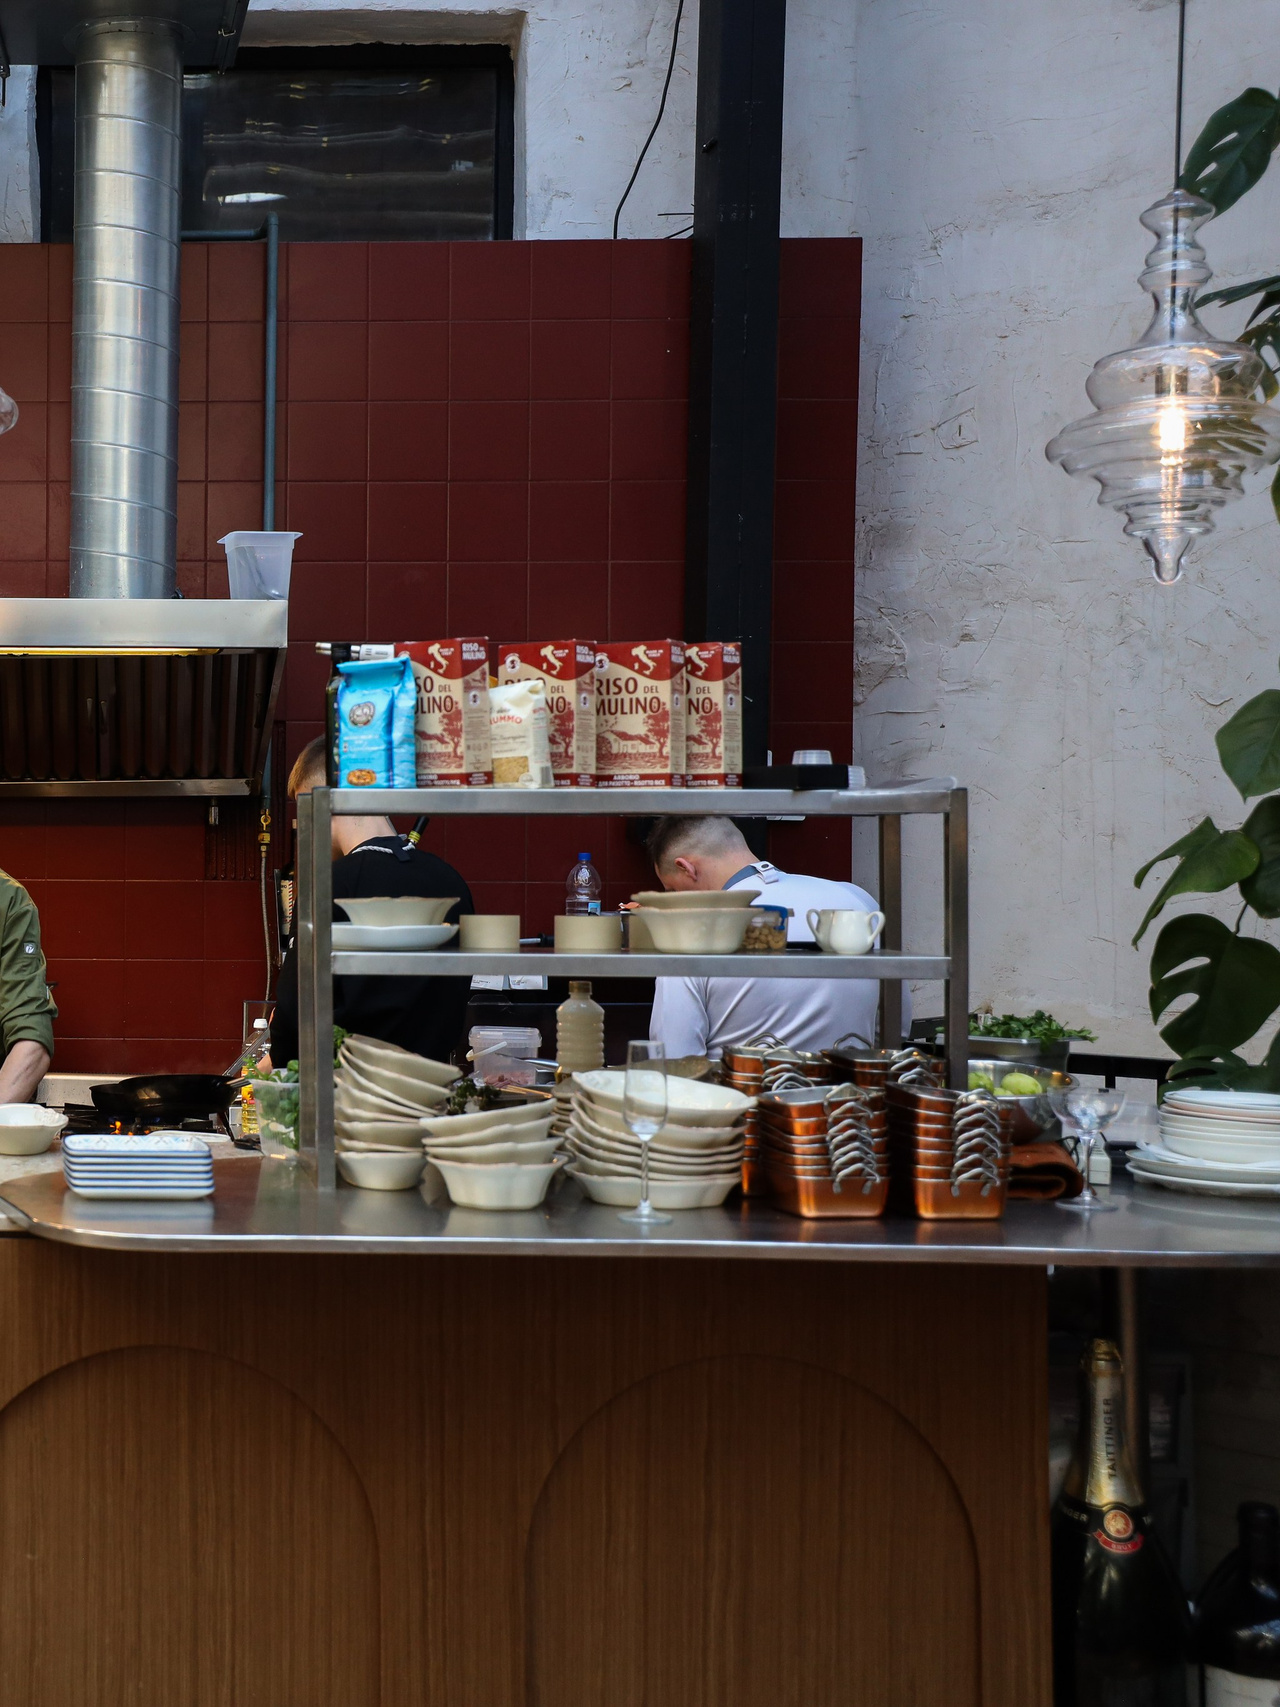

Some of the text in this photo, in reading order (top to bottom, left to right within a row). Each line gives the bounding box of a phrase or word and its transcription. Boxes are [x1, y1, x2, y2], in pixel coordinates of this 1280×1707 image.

[438, 684, 452, 693] DEL
[550, 686, 565, 694] DEL
[596, 677, 659, 696] RISO DEL
[696, 686, 711, 694] DEL
[414, 695, 454, 715] LINO
[596, 696, 661, 716] MULINO
[1102, 1397, 1117, 1480] TAITTINGER
